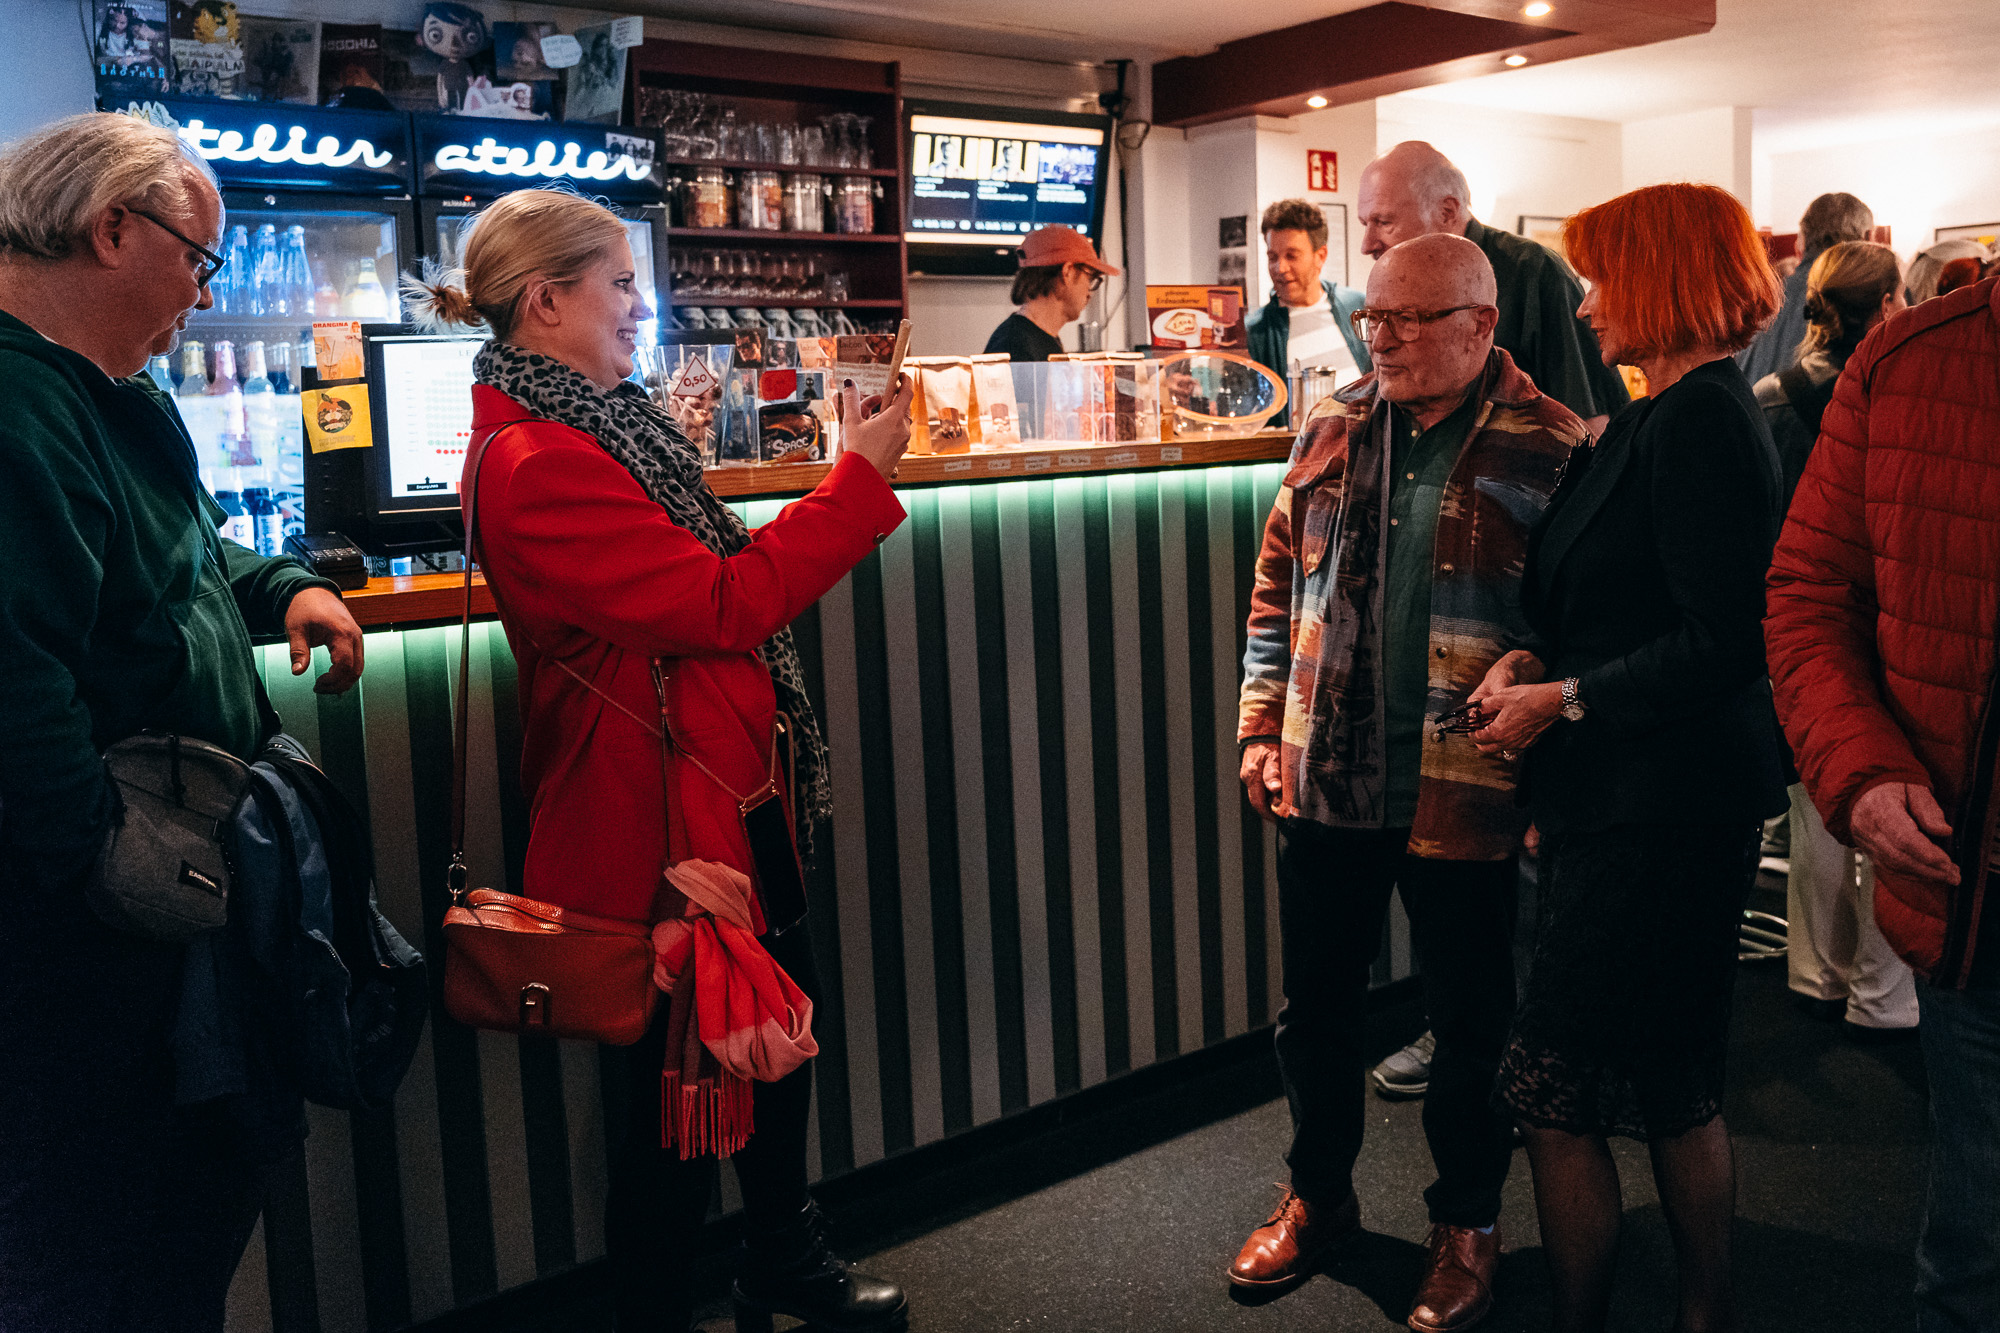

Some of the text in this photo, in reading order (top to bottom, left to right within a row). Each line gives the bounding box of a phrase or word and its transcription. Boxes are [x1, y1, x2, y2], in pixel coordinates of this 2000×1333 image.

[177, 119, 394, 168] telier
[435, 137, 651, 181] atelier
[683, 374, 707, 387] 0,50
